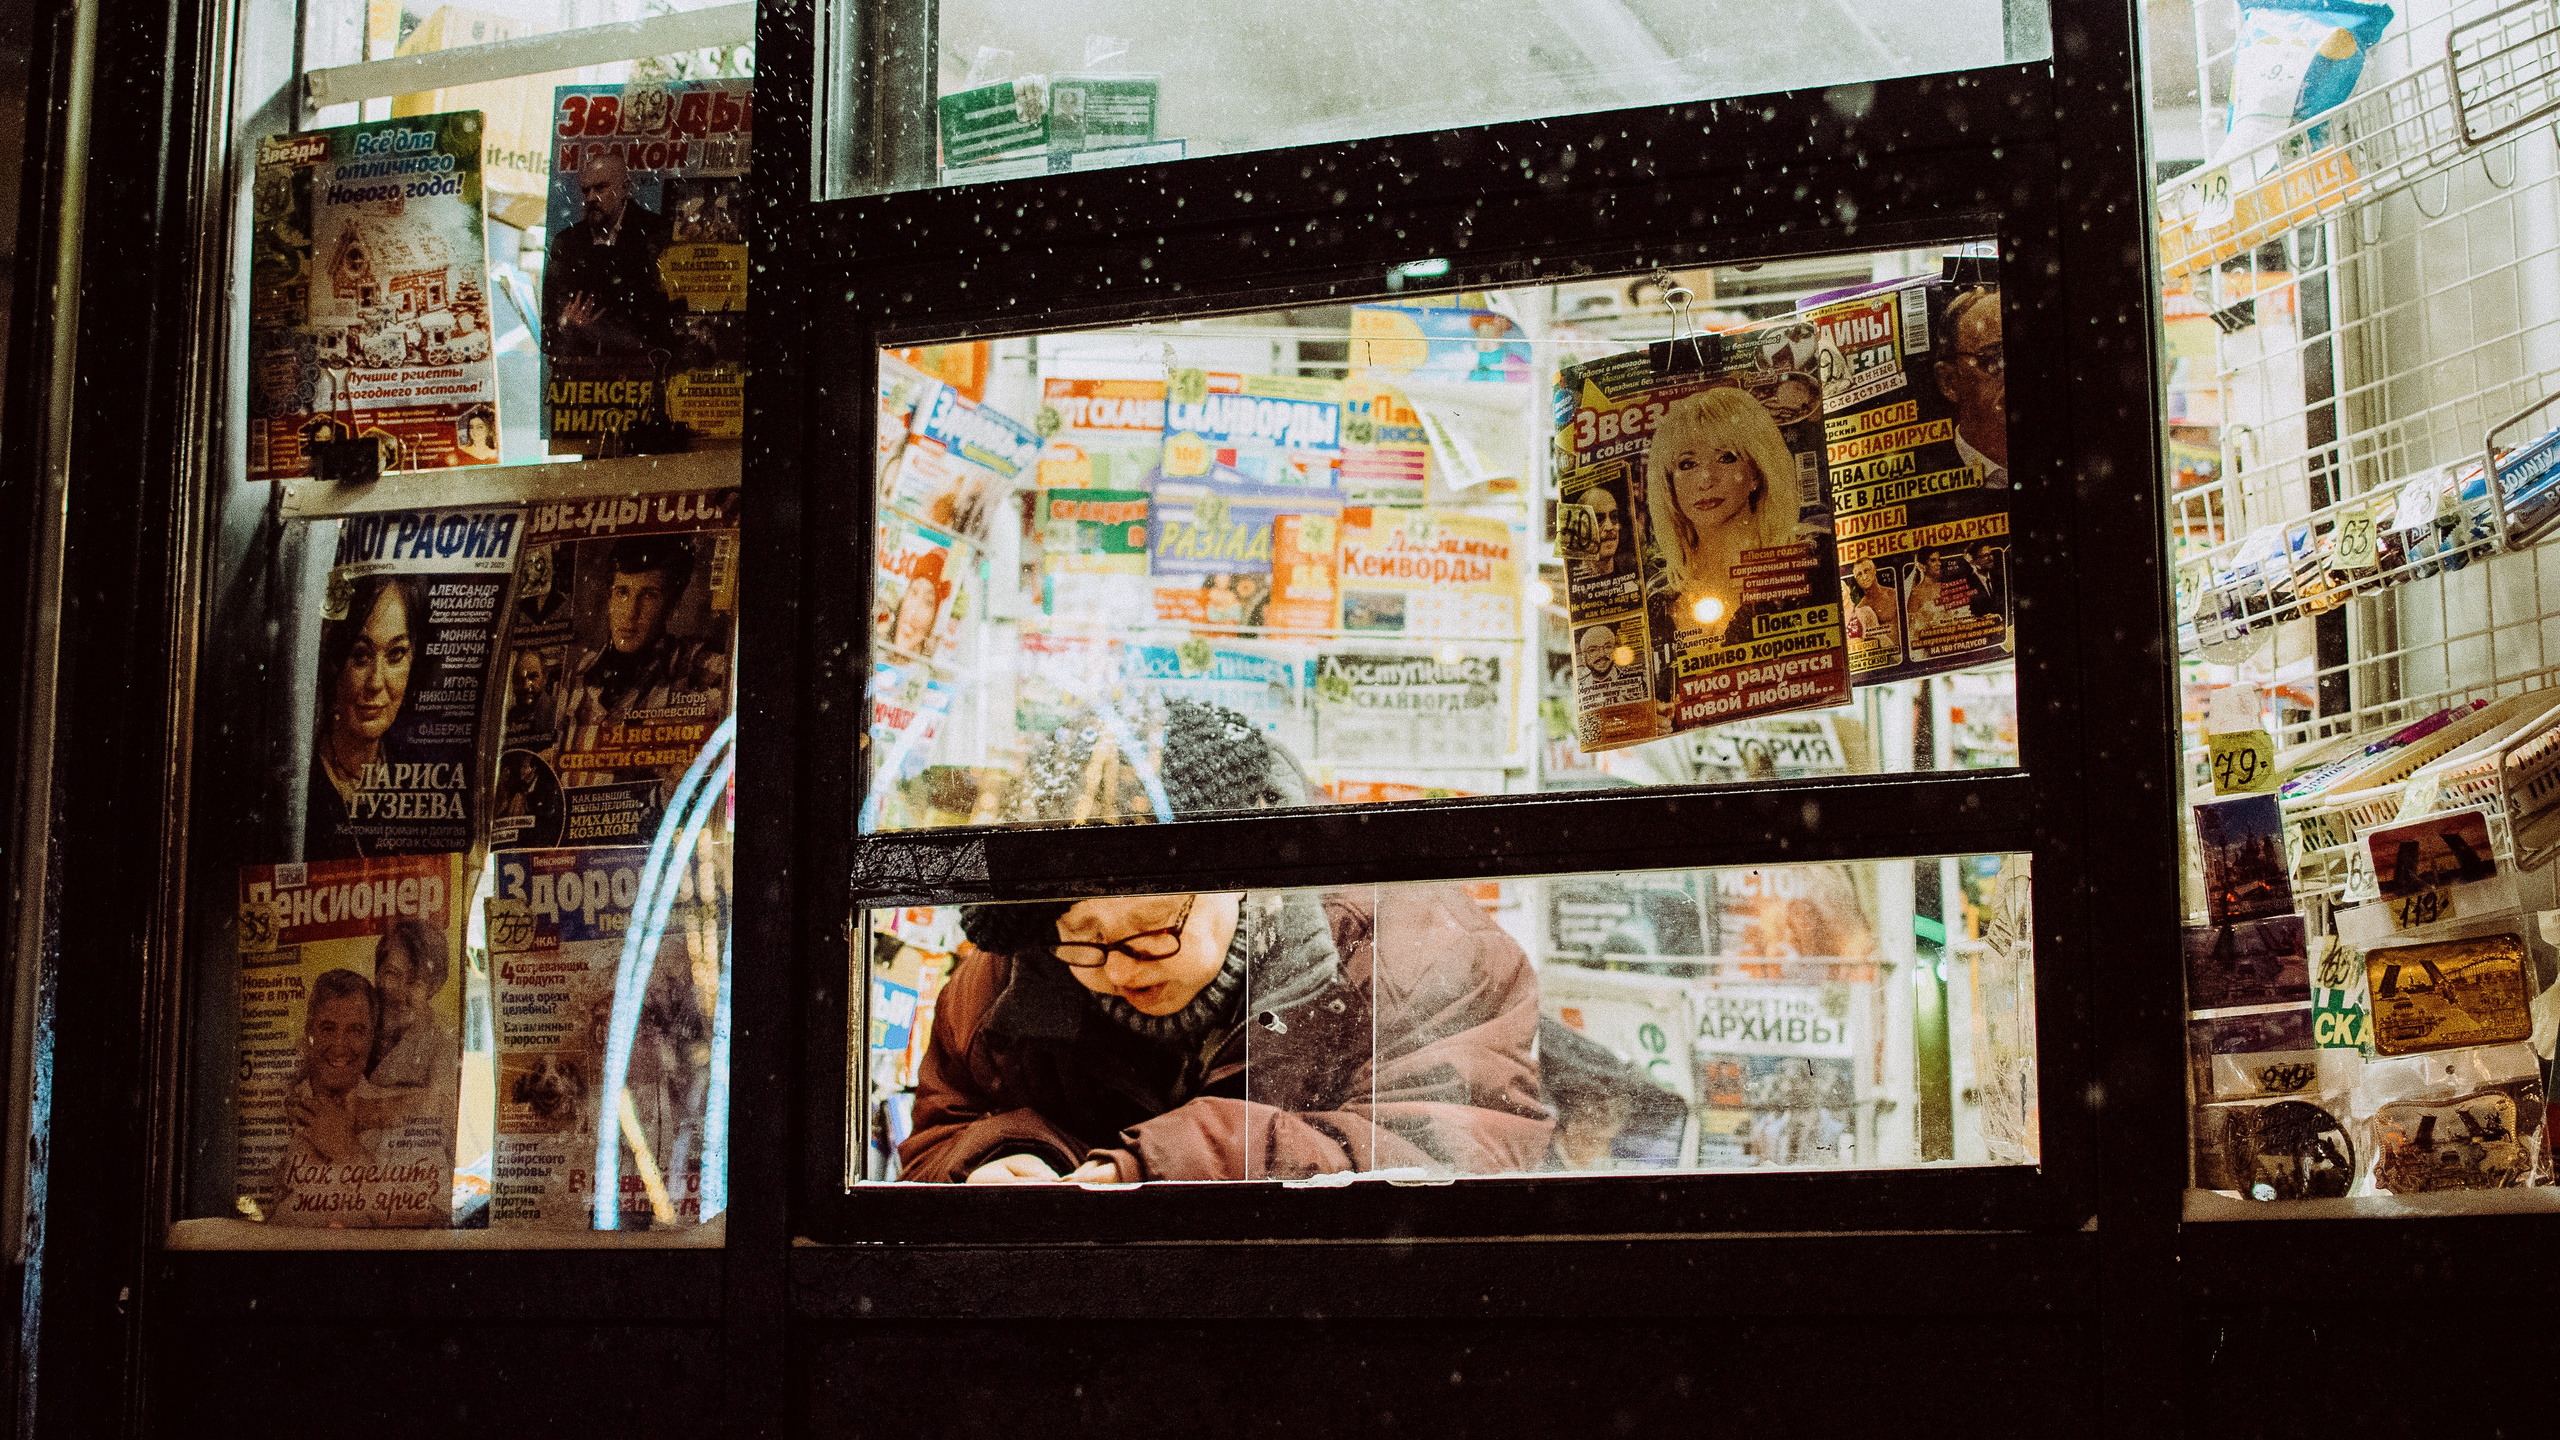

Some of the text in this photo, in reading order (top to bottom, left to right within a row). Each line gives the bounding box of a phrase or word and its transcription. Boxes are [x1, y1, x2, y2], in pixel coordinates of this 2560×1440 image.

[558, 91, 752, 140] ЗВДЫ
[355, 127, 436, 156] Всё для
[559, 143, 580, 172] И
[335, 154, 455, 181] отличного
[326, 170, 466, 206] Нового года!
[415, 380, 483, 398] застолья!
[548, 380, 654, 404] АЛЕКСЕЯ
[1168, 394, 1338, 447] СКАНВОРДЫ
[1860, 402, 1917, 431] ПОСЛЕ
[1827, 425, 1856, 440] рский
[1827, 420, 1953, 463] ОРОНАВИРУСА
[1831, 454, 1915, 490] ДВА ГОДА
[1856, 491, 1868, 507] В
[1872, 468, 1982, 506] ДЕПРЕССИИ,
[1837, 513, 2009, 565] ПЕРЕНЕС ИНФАРКТ!
[2340, 518, 2370, 557] 63
[1732, 556, 1818, 577] сокровенная тайна
[1587, 579, 1612, 591] время
[1745, 573, 1805, 588] отшельницы
[428, 583, 500, 600] АЛЕКСАНДР
[1742, 585, 1810, 601] Императрицы!
[1757, 608, 1829, 635] Пока ее
[440, 629, 486, 642] МОНИКА
[1673, 626, 1703, 642] Ирина
[1676, 634, 1725, 651] Аллегрова
[425, 643, 486, 655] БЕЛЛУЧЧИ
[1681, 631, 1831, 674] заживо хоронят,
[1931, 646, 1941, 655] НА
[1953, 637, 1987, 650] ГРАДУСОВ
[443, 676, 478, 688] ИГОРЬ
[1683, 654, 1834, 696] тихо радуется
[419, 690, 477, 702] НИКОЛАЕВ
[671, 691, 708, 706] Игорь
[1680, 679, 1835, 721] новой любви...
[418, 723, 473, 736] ФАБЕРЖЕ
[627, 726, 651, 743] не
[655, 724, 705, 742] смог
[558, 751, 633, 770] спасти
[353, 762, 467, 790] ЛАРИСА
[350, 792, 467, 819] ГУЗЕЕВА
[572, 794, 590, 804] КАК
[570, 810, 641, 828] МИХАИЛА
[568, 823, 639, 840] КОЗАКОВА
[249, 875, 445, 929] Пенсионер
[503, 863, 644, 926] Здоро
[242, 972, 306, 990] Новый год
[501, 960, 590, 985] 4 согревающих
[516, 974, 566, 987] продукта
[242, 991, 265, 1004] уже
[501, 992, 534, 1002] Какие
[1700, 1013, 1847, 1046] АРХИВЫ
[286, 1154, 332, 1184] Как
[497, 1167, 552, 1179] здоровья
[496, 1181, 546, 1196] Крапива
[293, 1190, 366, 1211] жизнь
[494, 1207, 541, 1221] диабета
